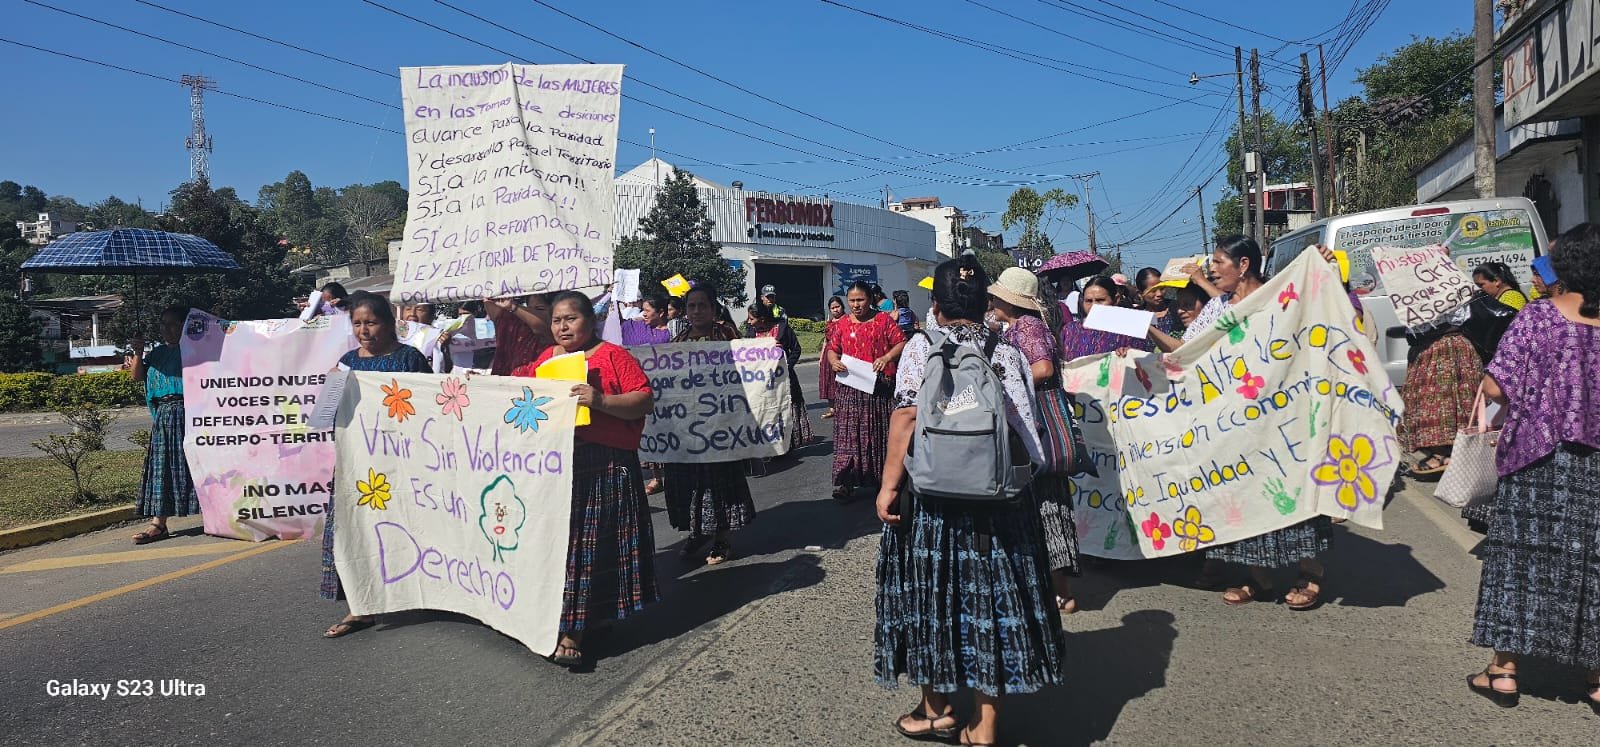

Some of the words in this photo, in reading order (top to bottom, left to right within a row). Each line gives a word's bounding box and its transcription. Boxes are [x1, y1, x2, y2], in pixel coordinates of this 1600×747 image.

[418, 68, 443, 89] La
[513, 67, 534, 87] de
[538, 74, 560, 90] las
[562, 79, 619, 96] MUJERES
[415, 106, 441, 119] en
[450, 104, 475, 118] las
[526, 121, 545, 134] la
[473, 168, 487, 184] la
[471, 194, 486, 210] la
[746, 197, 834, 227] FERROMAX
[442, 235, 459, 250] a
[464, 225, 480, 244] la
[584, 221, 602, 240] la
[1341, 236, 1385, 248] celebrar
[1389, 233, 1404, 242] tus
[1408, 229, 1442, 240] fiestas
[1350, 227, 1391, 239] espacio
[1395, 222, 1421, 233] ideal
[1424, 220, 1450, 231] para
[403, 262, 442, 284] LEY
[523, 244, 540, 263] DE
[200, 376, 273, 389] UNIENDO
[681, 369, 706, 389] de
[709, 365, 784, 390] trabajo
[1166, 380, 1193, 413] de
[1195, 346, 1248, 404] Alta
[216, 396, 270, 407] VOCES
[274, 395, 316, 406] PAR
[193, 414, 268, 427] DEFENSA
[273, 414, 297, 425] DE
[687, 412, 784, 454] Sexual
[420, 417, 457, 471] Sin
[462, 425, 562, 475] Violencia
[1153, 453, 1254, 512] Igualdad
[443, 489, 468, 522] un
[374, 521, 515, 610] Derecho
